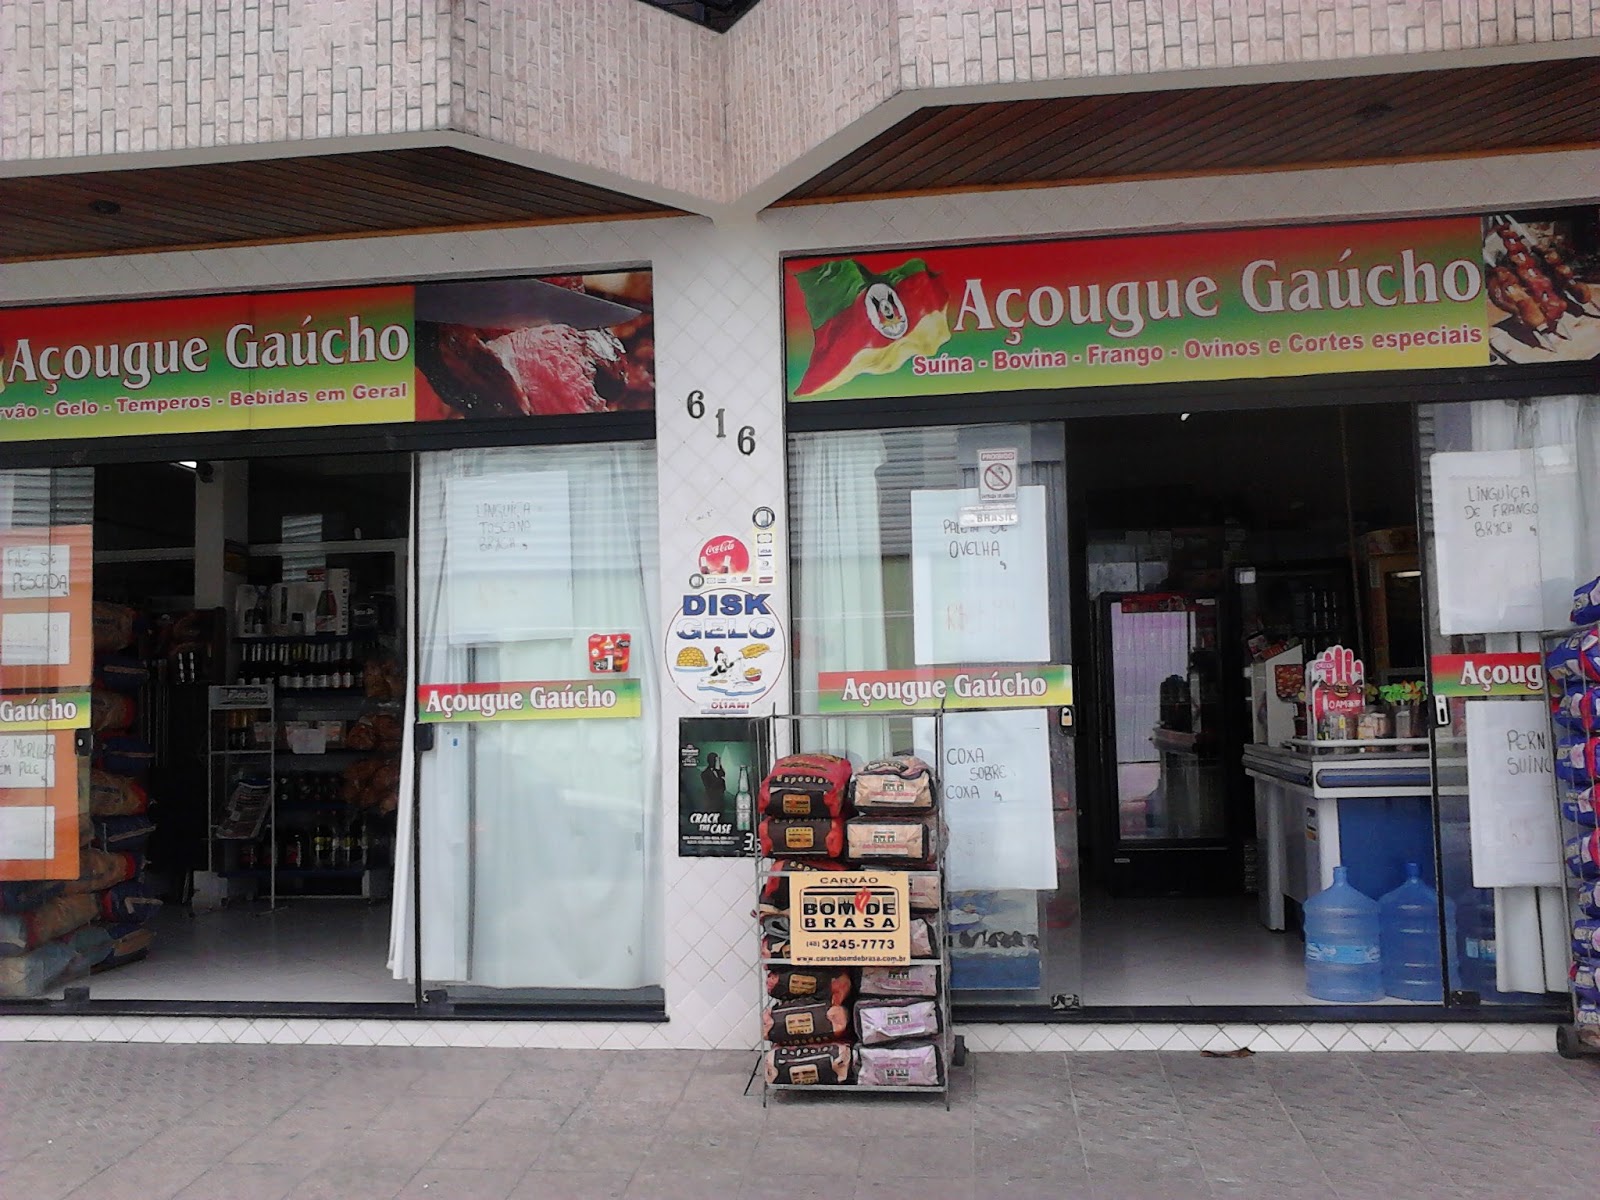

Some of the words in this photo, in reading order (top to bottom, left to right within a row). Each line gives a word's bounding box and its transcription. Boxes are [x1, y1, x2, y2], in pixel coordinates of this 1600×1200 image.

[953, 275, 1218, 345] Açougue
[1241, 248, 1482, 313] Gaúcho
[7, 336, 208, 394] Açougue
[226, 315, 410, 369] Gaúcho
[913, 354, 973, 375] Suína
[993, 351, 1067, 371] Bovina
[1087, 345, 1163, 366] Frango
[1184, 339, 1261, 358] Ovinos
[1269, 339, 1281, 353] e
[1289, 332, 1364, 352] Cortes
[1372, 325, 1483, 351] especiais
[55, 401, 98, 417] Gelo
[117, 395, 211, 415] Temperos
[230, 390, 308, 407] Bebidas
[316, 390, 345, 403] em
[353, 382, 408, 400] Geral
[977, 514, 1015, 522] BRASIL
[1492, 503, 1539, 518] FRANGO
[949, 541, 1001, 558] OVELHA
[683, 594, 771, 616] DISK
[676, 617, 775, 640] GELO
[842, 677, 946, 707] Açougue
[954, 671, 1047, 698] Gaúcho
[0, 697, 77, 722] Gaúcho
[426, 689, 523, 717] Açougue
[530, 684, 616, 710] Gaúcho
[946, 747, 984, 766] COXA
[969, 764, 1007, 781] SOBRE
[945, 785, 981, 800] COXA
[690, 812, 720, 824] CRACK
[710, 823, 732, 835] CASE
[820, 876, 879, 884] CARVÃO
[803, 897, 856, 915] BOM
[865, 897, 896, 915] DE
[804, 918, 895, 928] BRASA
[822, 939, 895, 949] 3245-7773
